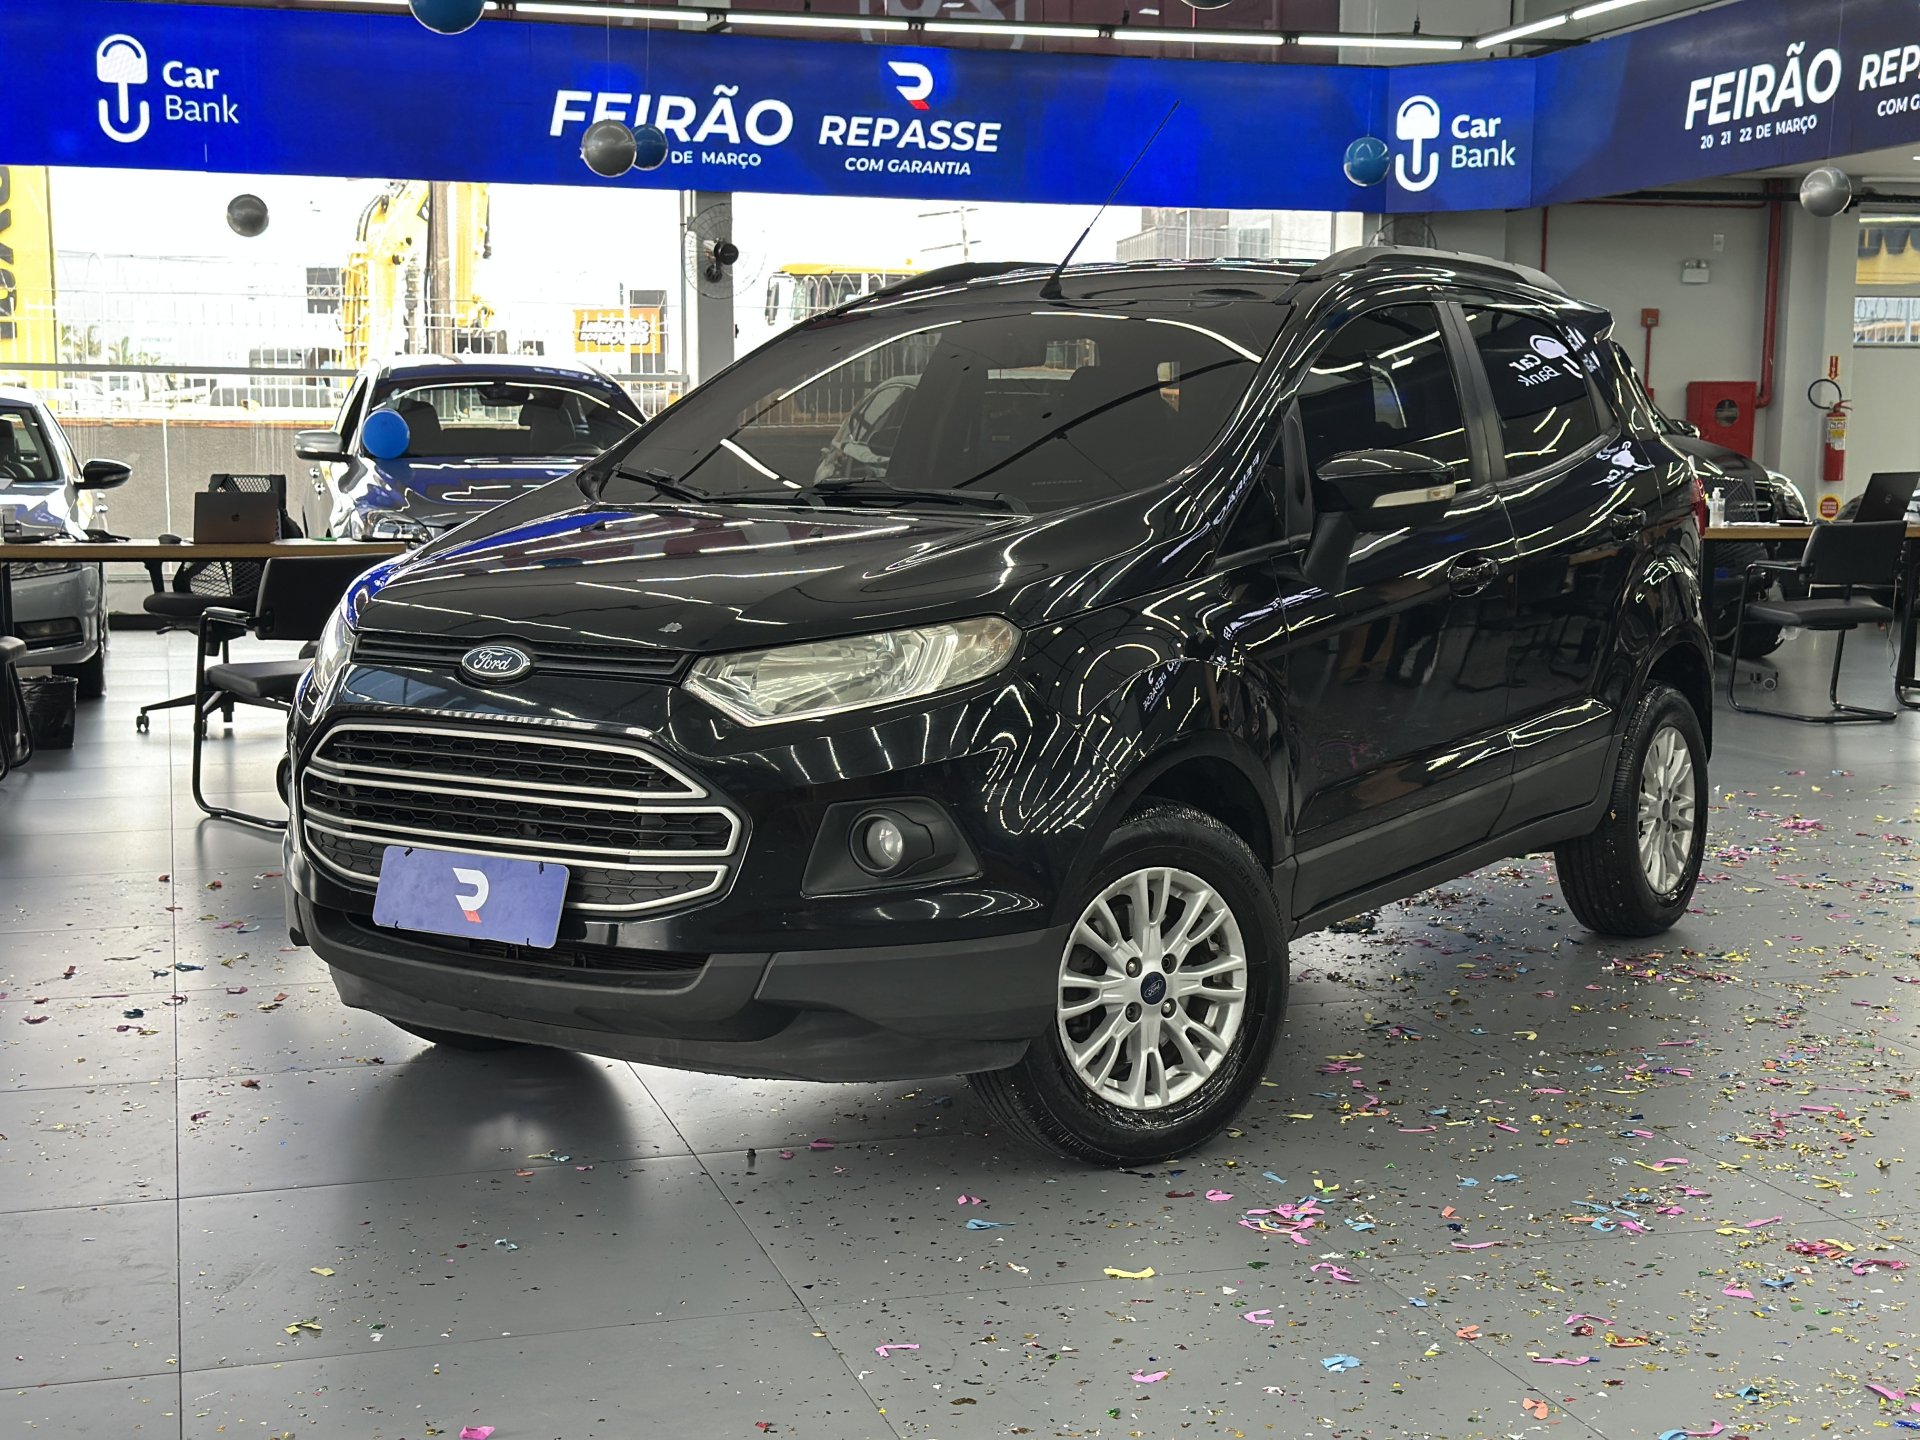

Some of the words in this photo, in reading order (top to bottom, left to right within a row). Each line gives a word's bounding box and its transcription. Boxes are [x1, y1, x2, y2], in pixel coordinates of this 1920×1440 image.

[162, 60, 220, 90] Car
[1858, 44, 1920, 91] REP
[1684, 41, 1842, 130] FEIRÃO
[165, 94, 239, 124] Bank
[550, 84, 794, 146] FEIRÃO
[1877, 97, 1908, 117] COM
[818, 115, 1002, 153] REPASSE
[1451, 114, 1501, 139] Car
[1700, 134, 1713, 150] 20
[1720, 131, 1731, 146] 21
[1739, 128, 1752, 143] 22
[1756, 123, 1771, 140] DE
[1775, 114, 1817, 134] MARÇO
[671, 151, 693, 164] DE
[702, 152, 762, 169] MARÇO
[844, 157, 883, 172] COM
[887, 159, 971, 176] GARANTIA
[1451, 139, 1516, 169] Bank
[473, 649, 513, 670] Ford
